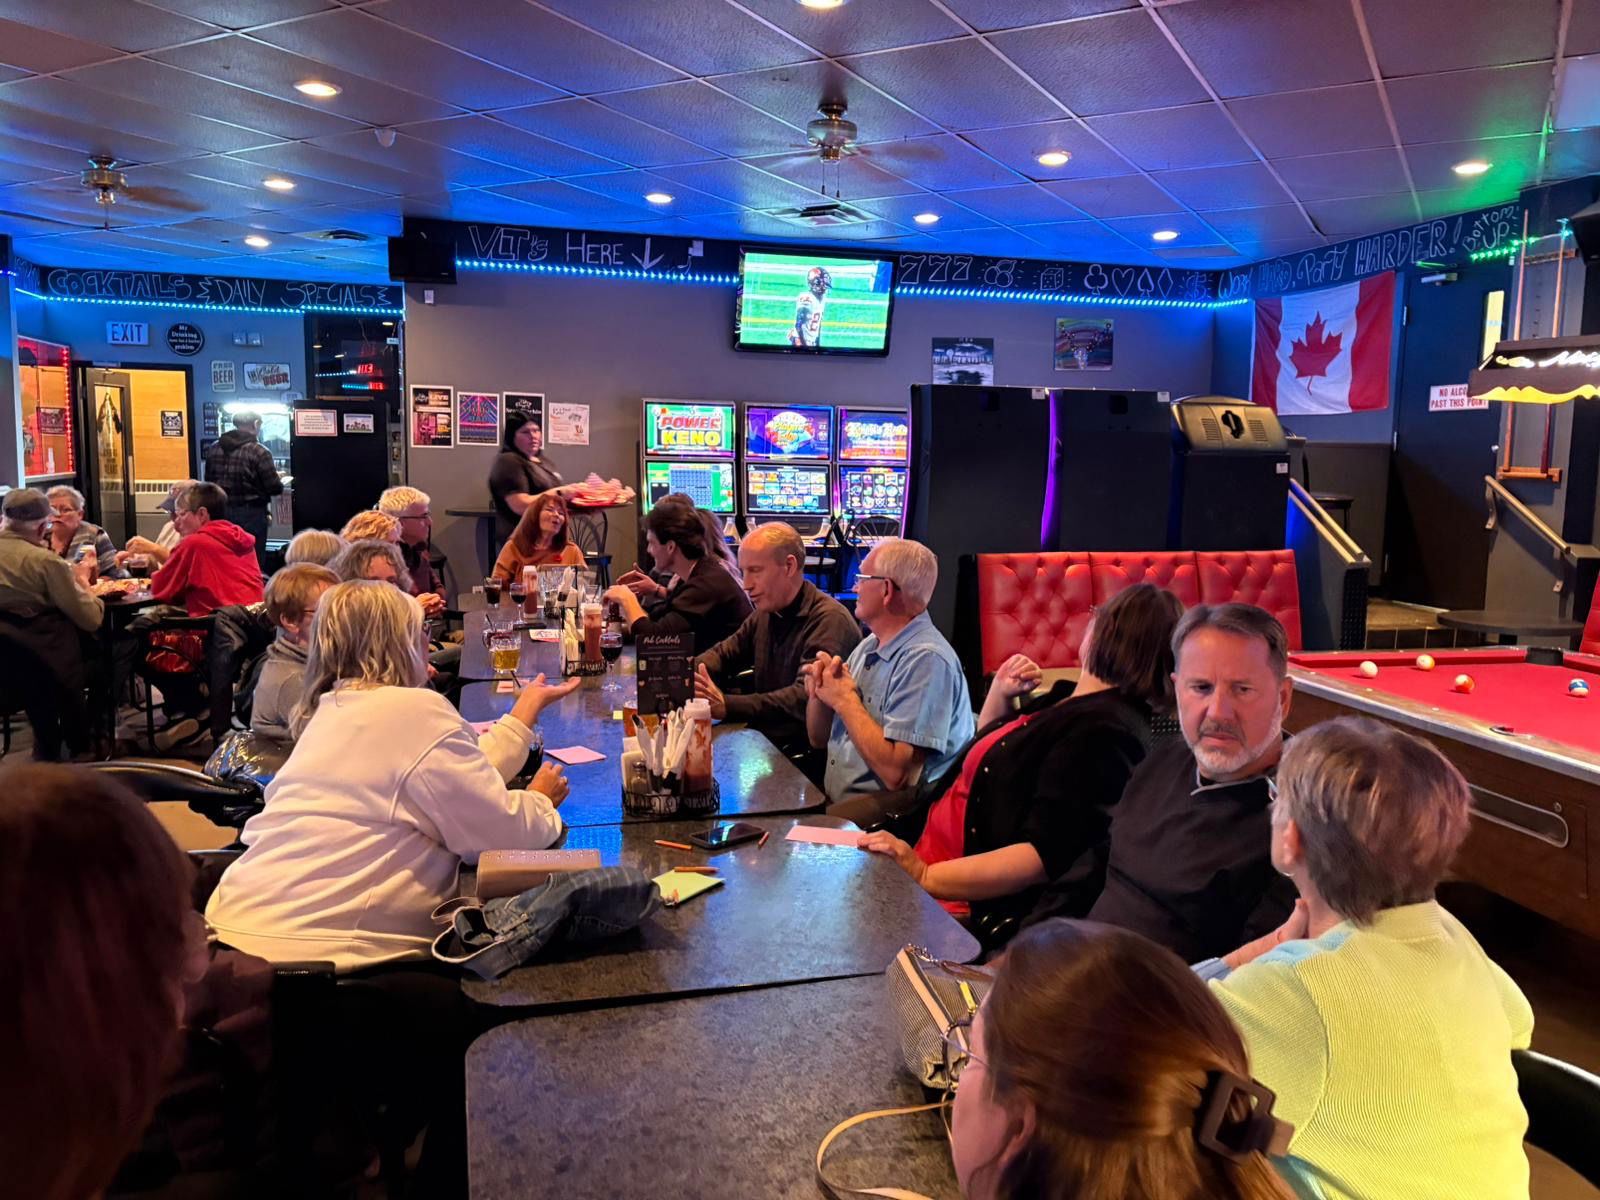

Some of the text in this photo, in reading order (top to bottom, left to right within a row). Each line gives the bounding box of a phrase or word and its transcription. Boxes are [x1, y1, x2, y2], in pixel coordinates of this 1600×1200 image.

[48, 269, 193, 300] COCKTAILS
[214, 279, 376, 308] DAILY SPECIALS
[111, 323, 143, 342] EXIT
[213, 370, 234, 384] BEER
[1439, 388, 1448, 397] NO
[1431, 399, 1447, 409] PAST
[1450, 398, 1465, 408] THIS
[660, 415, 721, 429] POWER
[660, 430, 721, 446] KENO
